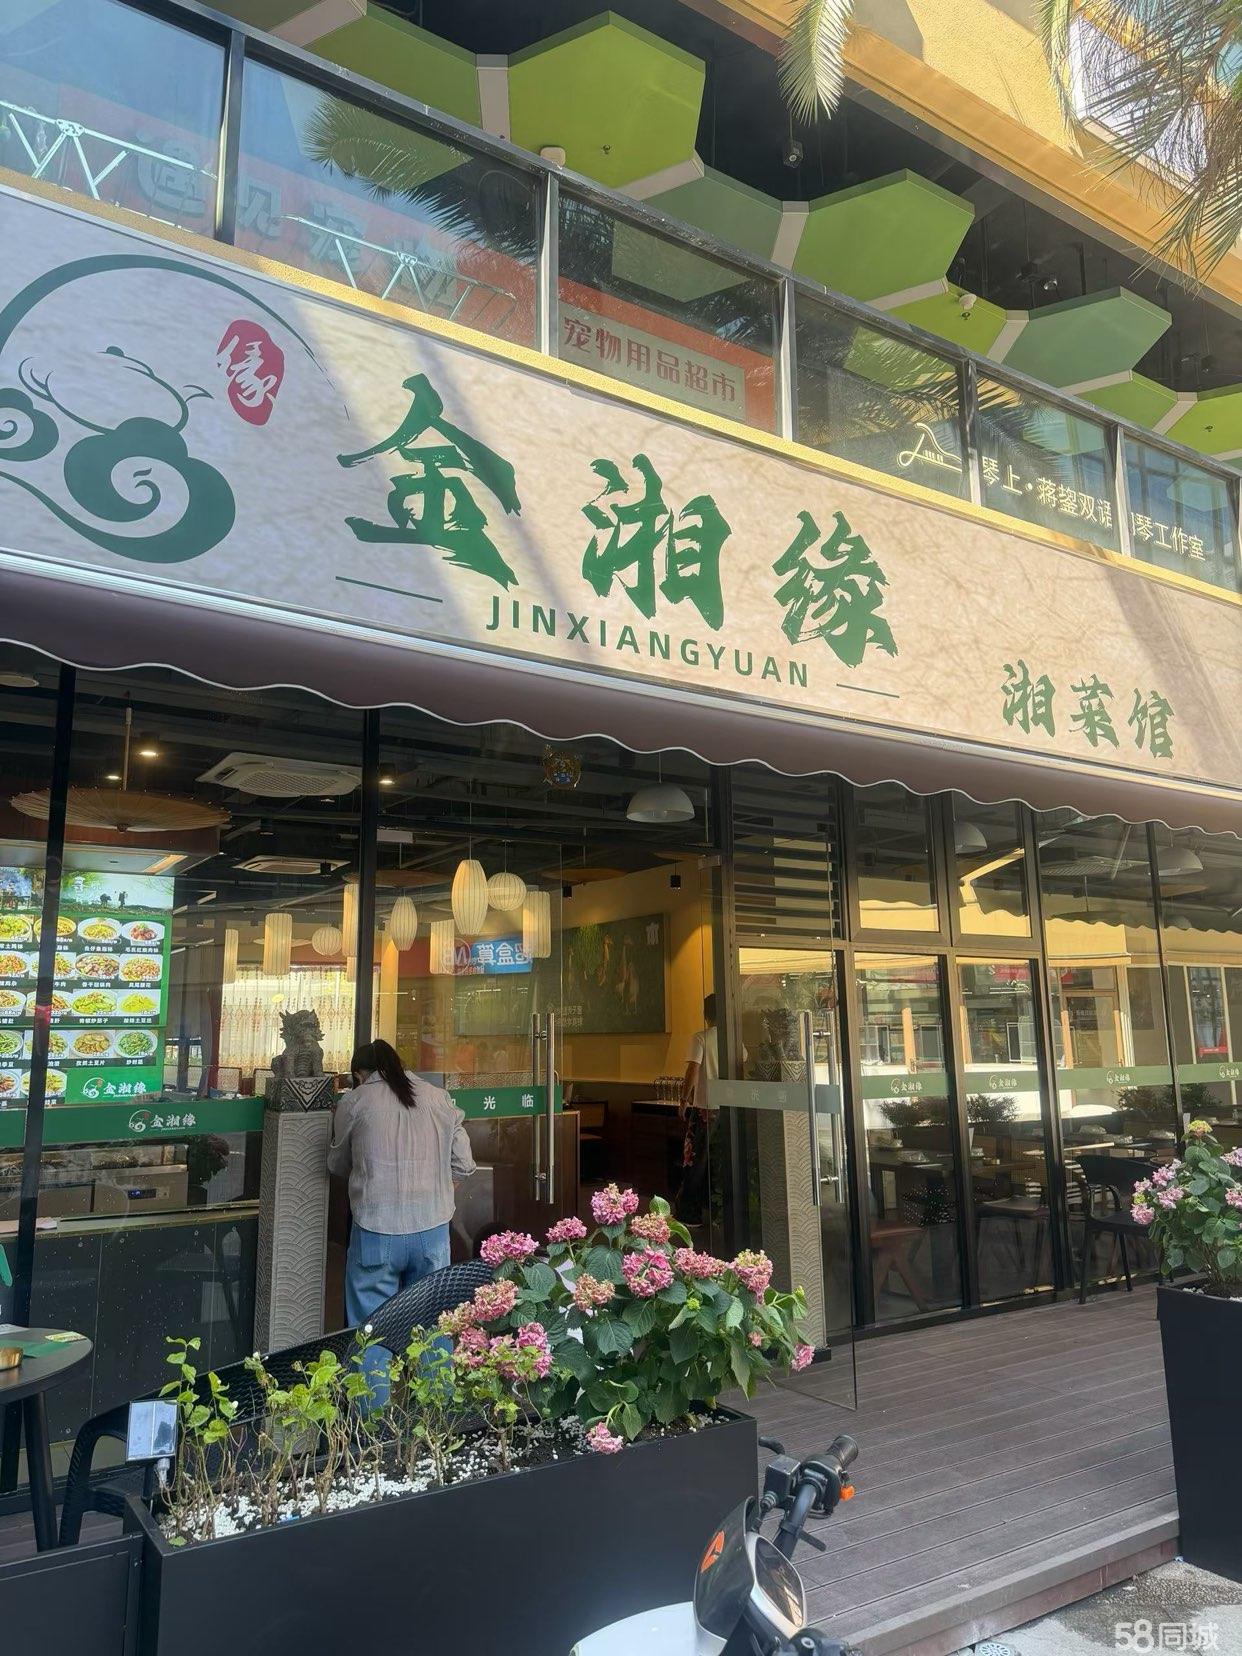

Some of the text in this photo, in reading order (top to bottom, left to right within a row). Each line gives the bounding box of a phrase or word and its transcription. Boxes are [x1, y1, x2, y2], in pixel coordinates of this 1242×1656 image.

[563, 316, 736, 402] 宠物用品超市
[486, 595, 809, 688] JINXIANGYUAN
[1001, 659, 1175, 760] 湘菜馆
[103, 1081, 147, 1095] 金湘缘
[452, 1093, 534, 1110] 光临
[149, 1113, 196, 1128] 金湘缘
